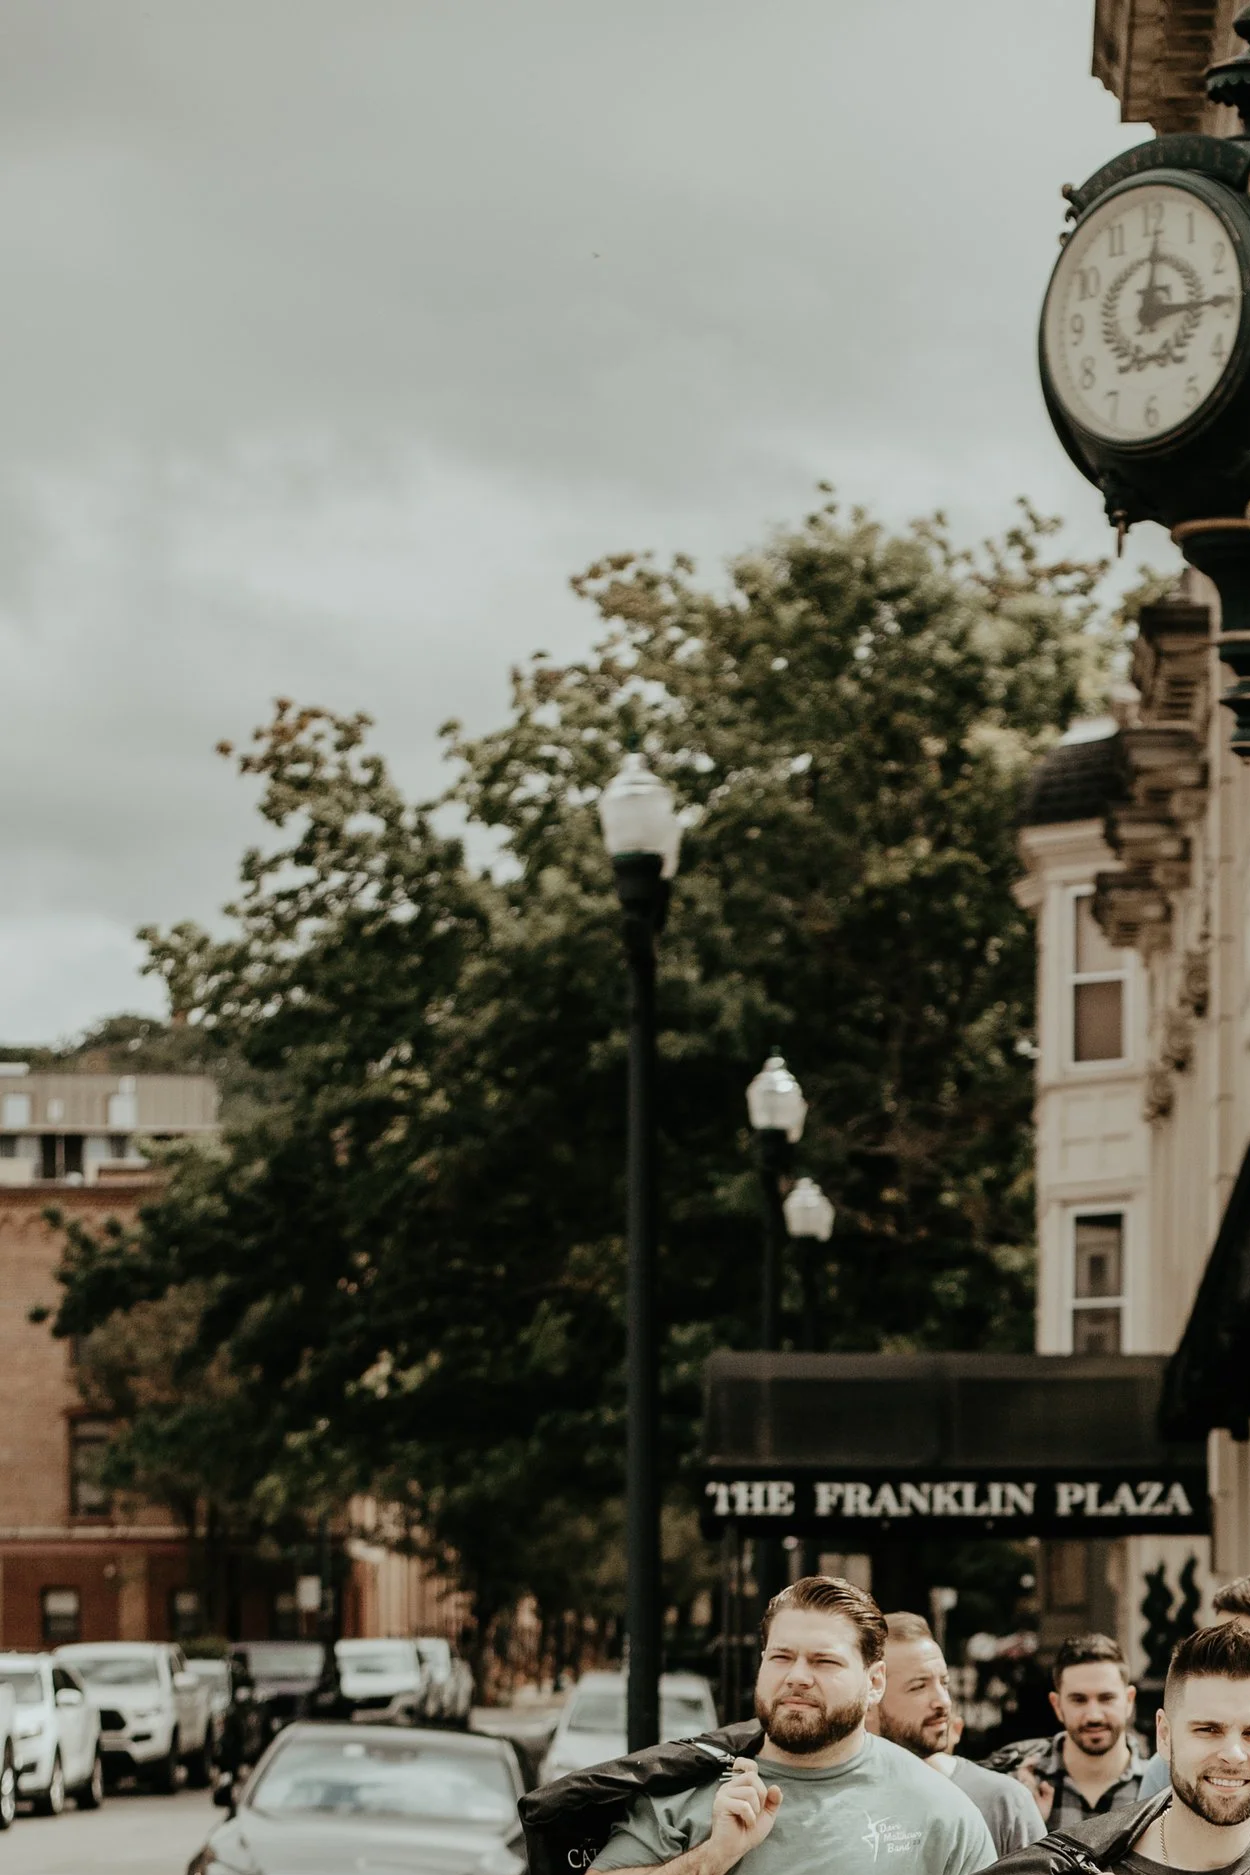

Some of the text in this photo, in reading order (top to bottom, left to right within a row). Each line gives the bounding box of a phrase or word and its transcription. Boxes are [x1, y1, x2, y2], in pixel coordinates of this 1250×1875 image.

[1140, 202, 1164, 238] 12
[1186, 210, 1195, 244] 1
[1108, 223, 1126, 258] 11
[1211, 241, 1226, 275] 2
[1073, 265, 1100, 302] 10
[1069, 312, 1085, 347] 9
[1211, 332, 1226, 368] 4
[1079, 354, 1096, 391] 8
[1106, 389, 1120, 423] 7
[1144, 395, 1160, 428] 6
[705, 1480, 1193, 1517] THE FRANKLIN PLAZA
[887, 1842, 911, 1853] Band
